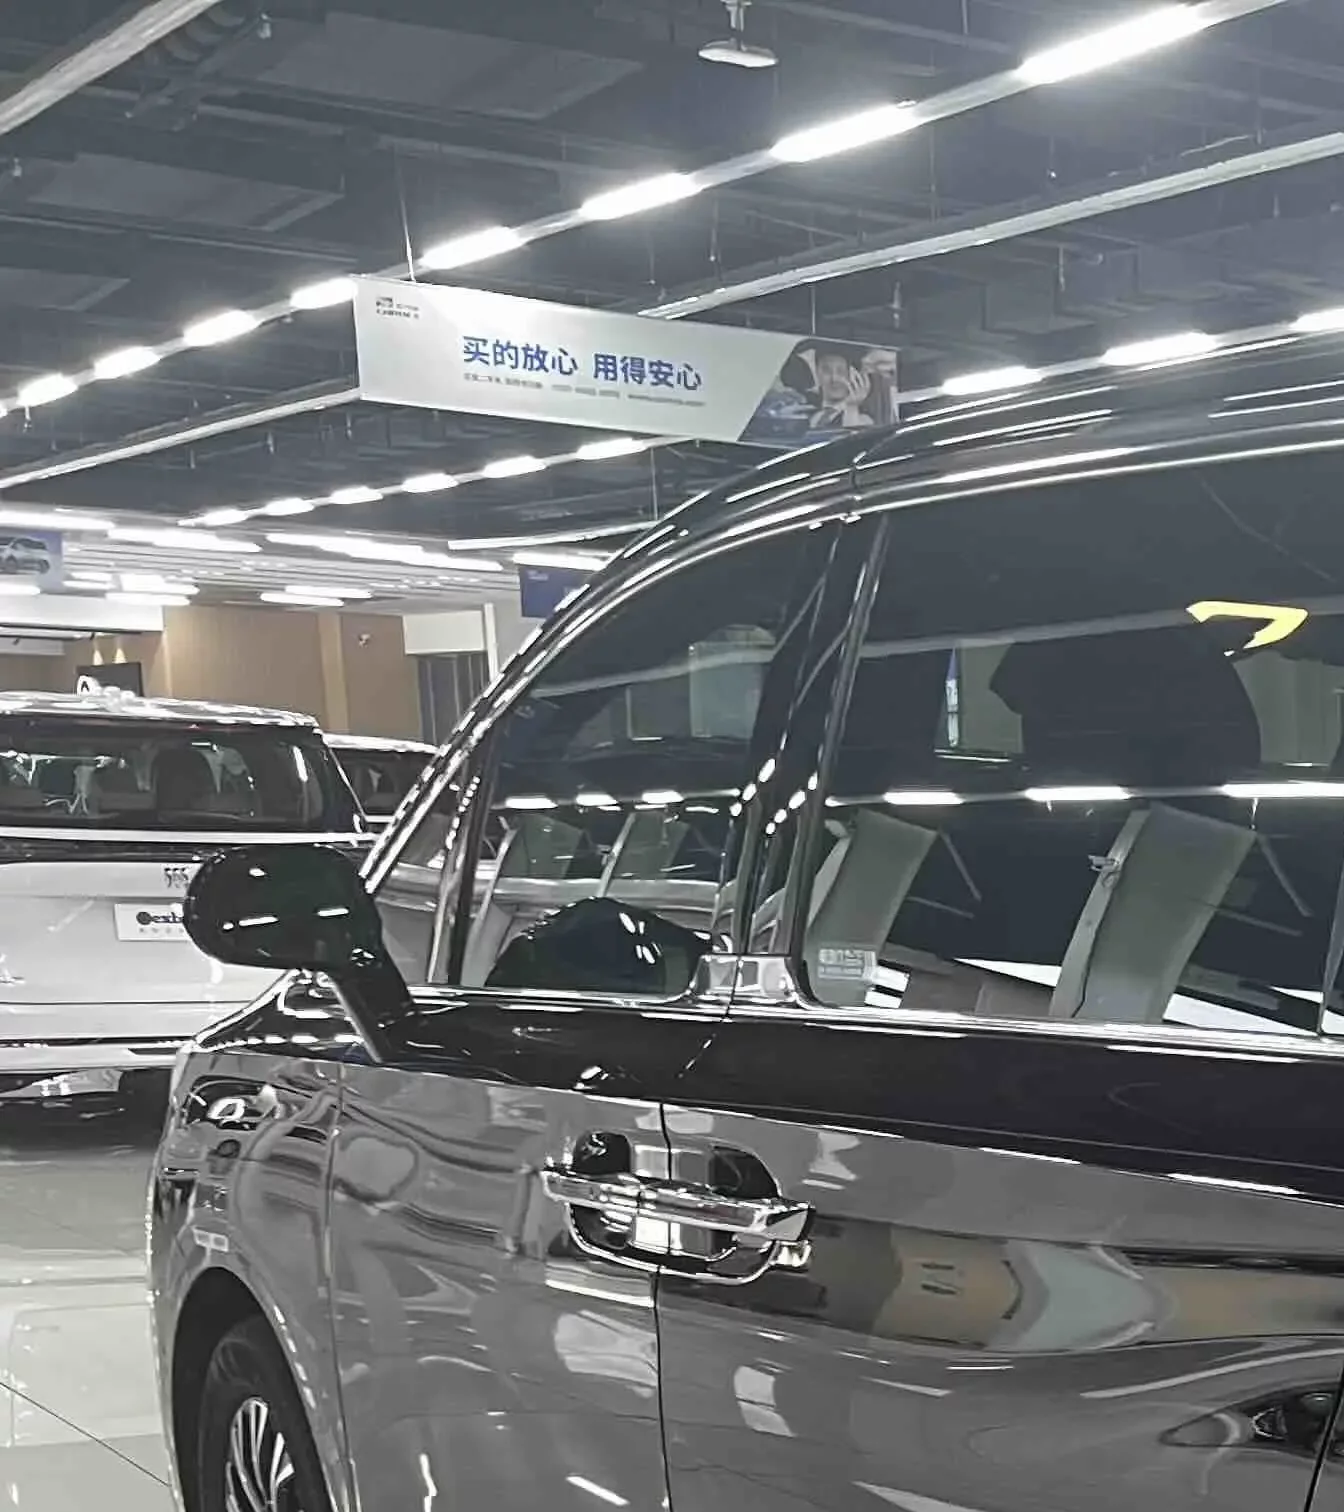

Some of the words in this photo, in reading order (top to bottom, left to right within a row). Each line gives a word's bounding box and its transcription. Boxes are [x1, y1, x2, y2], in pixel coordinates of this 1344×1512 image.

[463, 335, 578, 376] 买的放心
[593, 352, 702, 391] 用得安心
